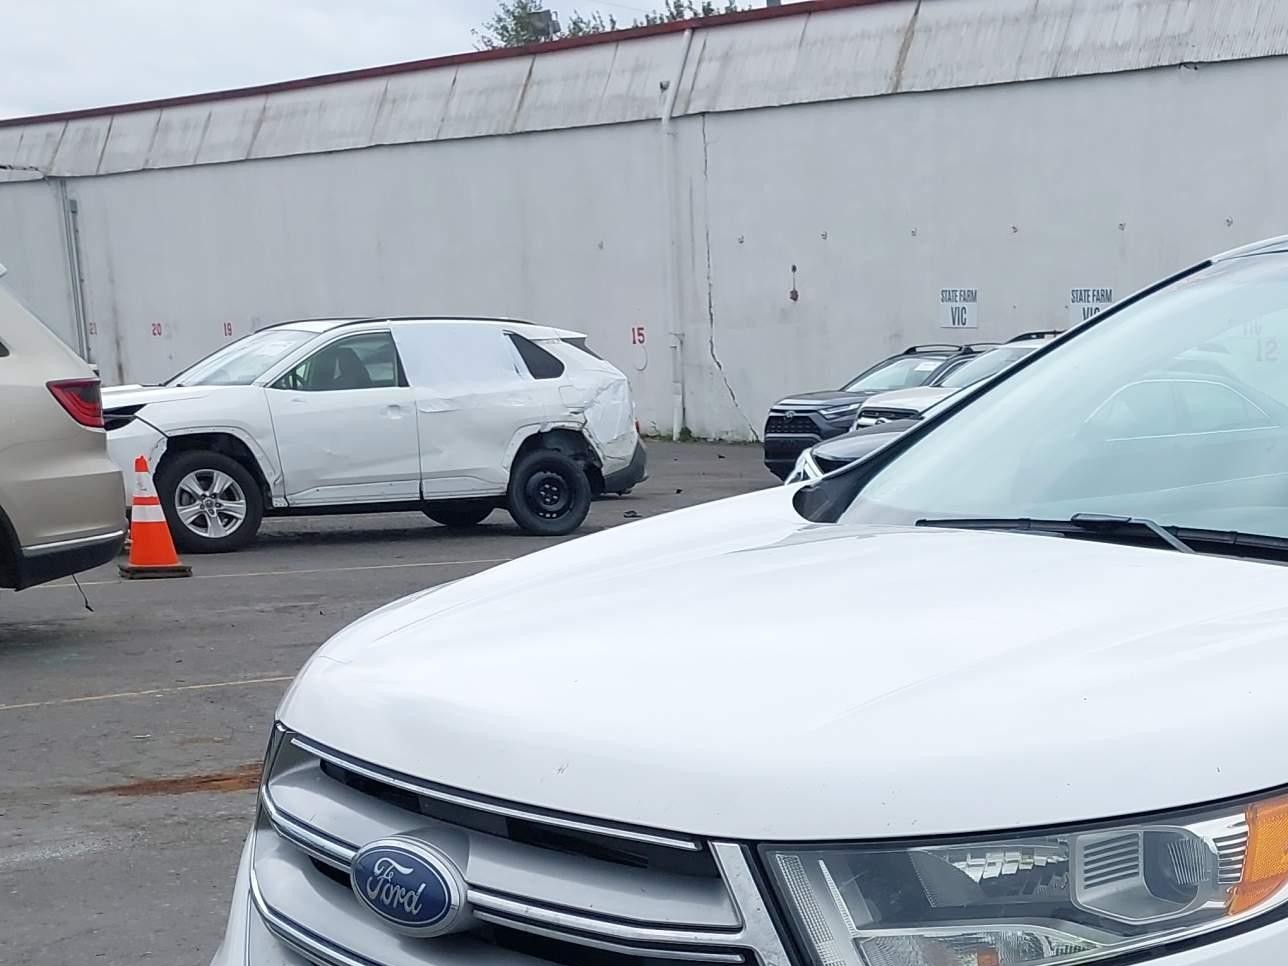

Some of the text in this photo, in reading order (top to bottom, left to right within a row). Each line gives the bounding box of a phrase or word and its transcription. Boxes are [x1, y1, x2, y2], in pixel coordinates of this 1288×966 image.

[941, 289, 977, 303] STATE FARM
[1071, 289, 1112, 304] STATE FARM
[950, 306, 967, 326] VIC
[151, 322, 162, 337] 20
[223, 322, 233, 337] 19
[631, 327, 646, 345] 15
[366, 857, 427, 916] Ford
